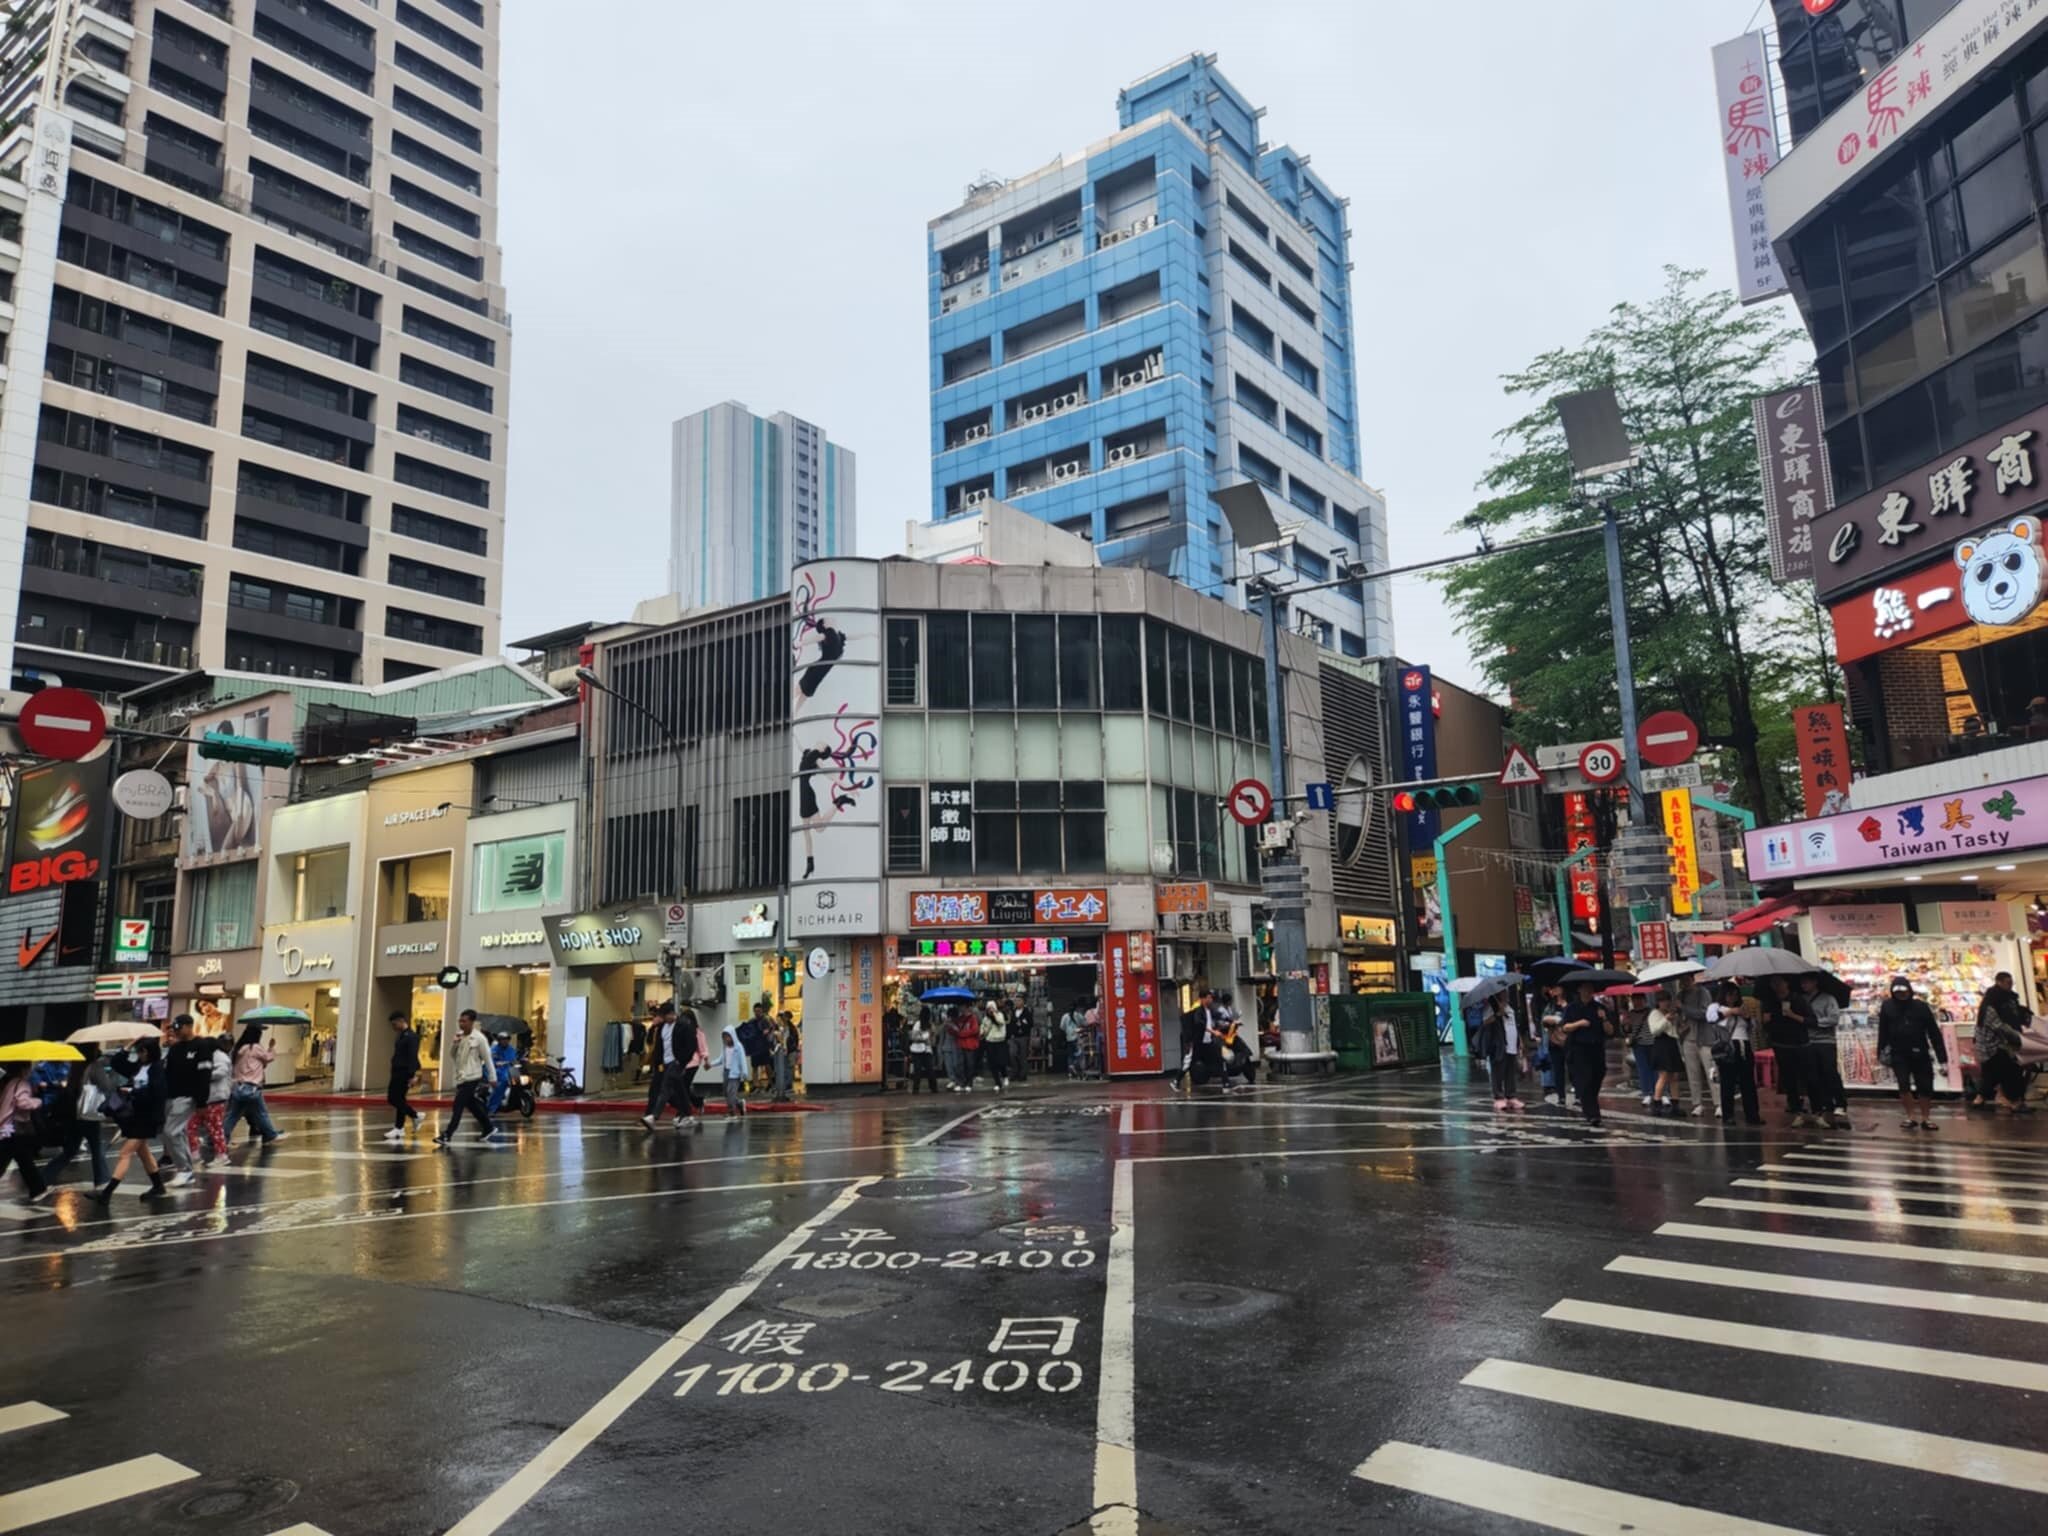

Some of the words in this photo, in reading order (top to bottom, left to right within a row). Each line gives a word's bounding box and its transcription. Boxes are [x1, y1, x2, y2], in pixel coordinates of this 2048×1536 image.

[1873, 587, 1954, 639] 熊一
[1407, 694, 1425, 759] 永豐銀行
[1806, 710, 1839, 787] 熊一燒肉
[1510, 762, 1528, 778] 慢
[1589, 756, 1611, 771] 30
[384, 813, 398, 826] AIR
[400, 808, 426, 824] SPACE
[1858, 789, 2026, 843] 台灣美味
[1879, 840, 1948, 860] Taiwan
[1950, 829, 2011, 850] Tasty
[915, 895, 985, 922] 劉福記
[1036, 892, 1104, 920] 手工傘
[385, 945, 397, 956] AIR
[399, 943, 416, 955] SPACE
[418, 941, 439, 954] LADY
[480, 934, 499, 948] new
[502, 929, 544, 946] balance
[559, 932, 601, 950] HOME
[605, 927, 641, 946] SHOP
[787, 1249, 1096, 1270] 1800-2400
[673, 1360, 1083, 1397] 1100-2400
